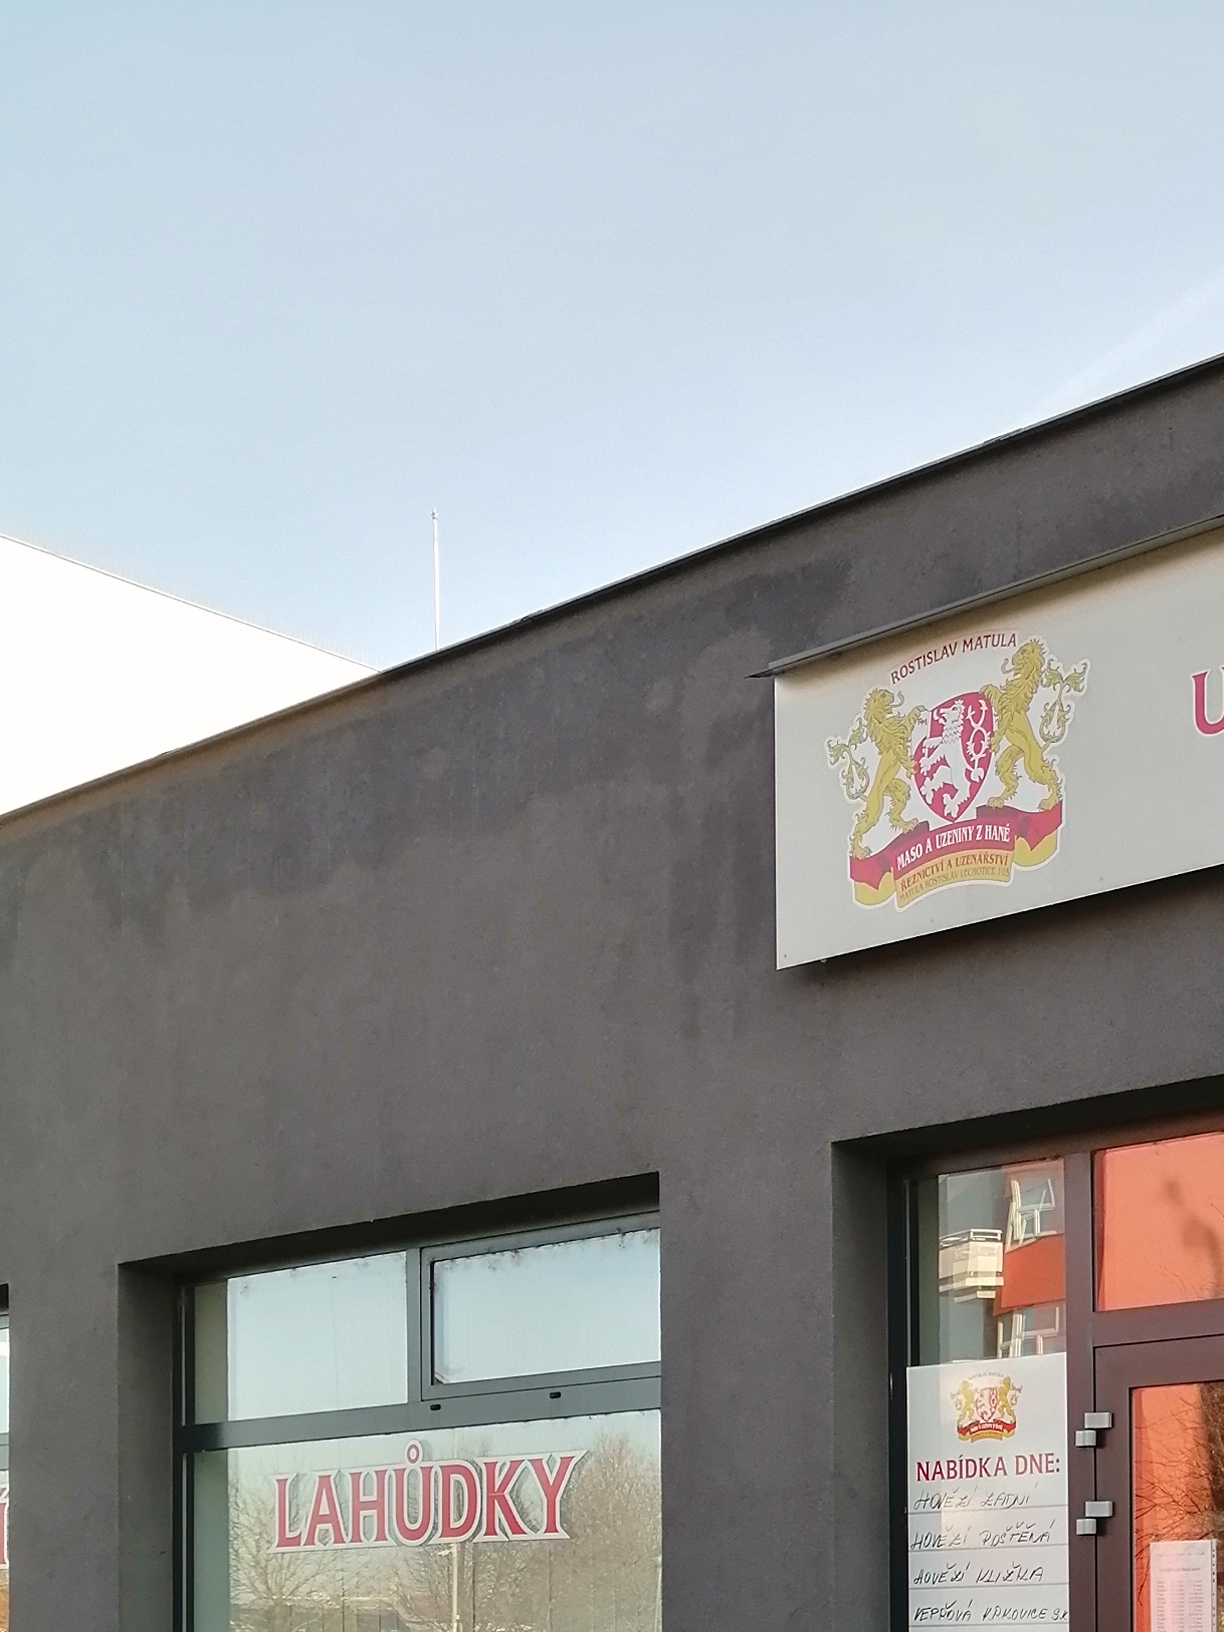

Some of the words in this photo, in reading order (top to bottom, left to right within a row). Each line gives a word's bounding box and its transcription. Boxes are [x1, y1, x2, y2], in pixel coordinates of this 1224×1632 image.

[890, 642, 957, 684] ROSTISLAV
[962, 633, 1016, 653] MATULA
[896, 843, 923, 870] MASO
[925, 838, 933, 854] A
[935, 825, 974, 849] UZENINY
[976, 824, 983, 841] Z
[984, 823, 1010, 842] HANÉ
[900, 859, 944, 891] ŘEZNICTVÍ
[947, 859, 953, 868] A
[955, 852, 1009, 866] UZENÁŘSTVÍ
[916, 1454, 1008, 1481] NABÍDKA
[1015, 1452, 1061, 1476] DNE:
[273, 1440, 585, 1551] LAHŮDKY
[914, 1599, 973, 1622] VEPŘOVÁ
